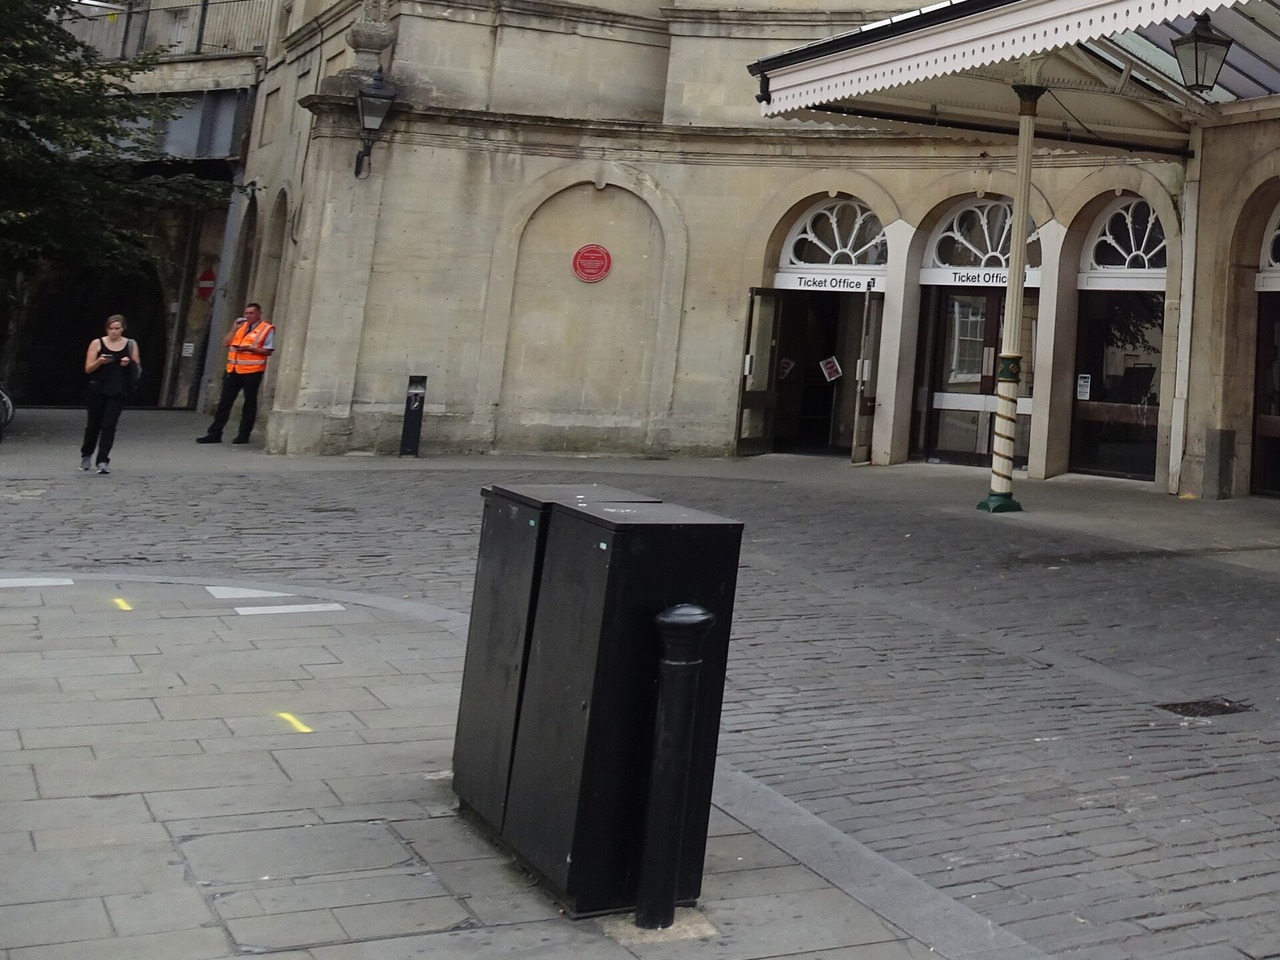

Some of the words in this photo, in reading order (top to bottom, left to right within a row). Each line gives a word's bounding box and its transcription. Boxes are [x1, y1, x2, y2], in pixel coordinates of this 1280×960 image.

[797, 277, 827, 289] Ticket
[829, 278, 861, 288] Office
[952, 272, 980, 283] Ticket
[983, 272, 1007, 284] Offic
